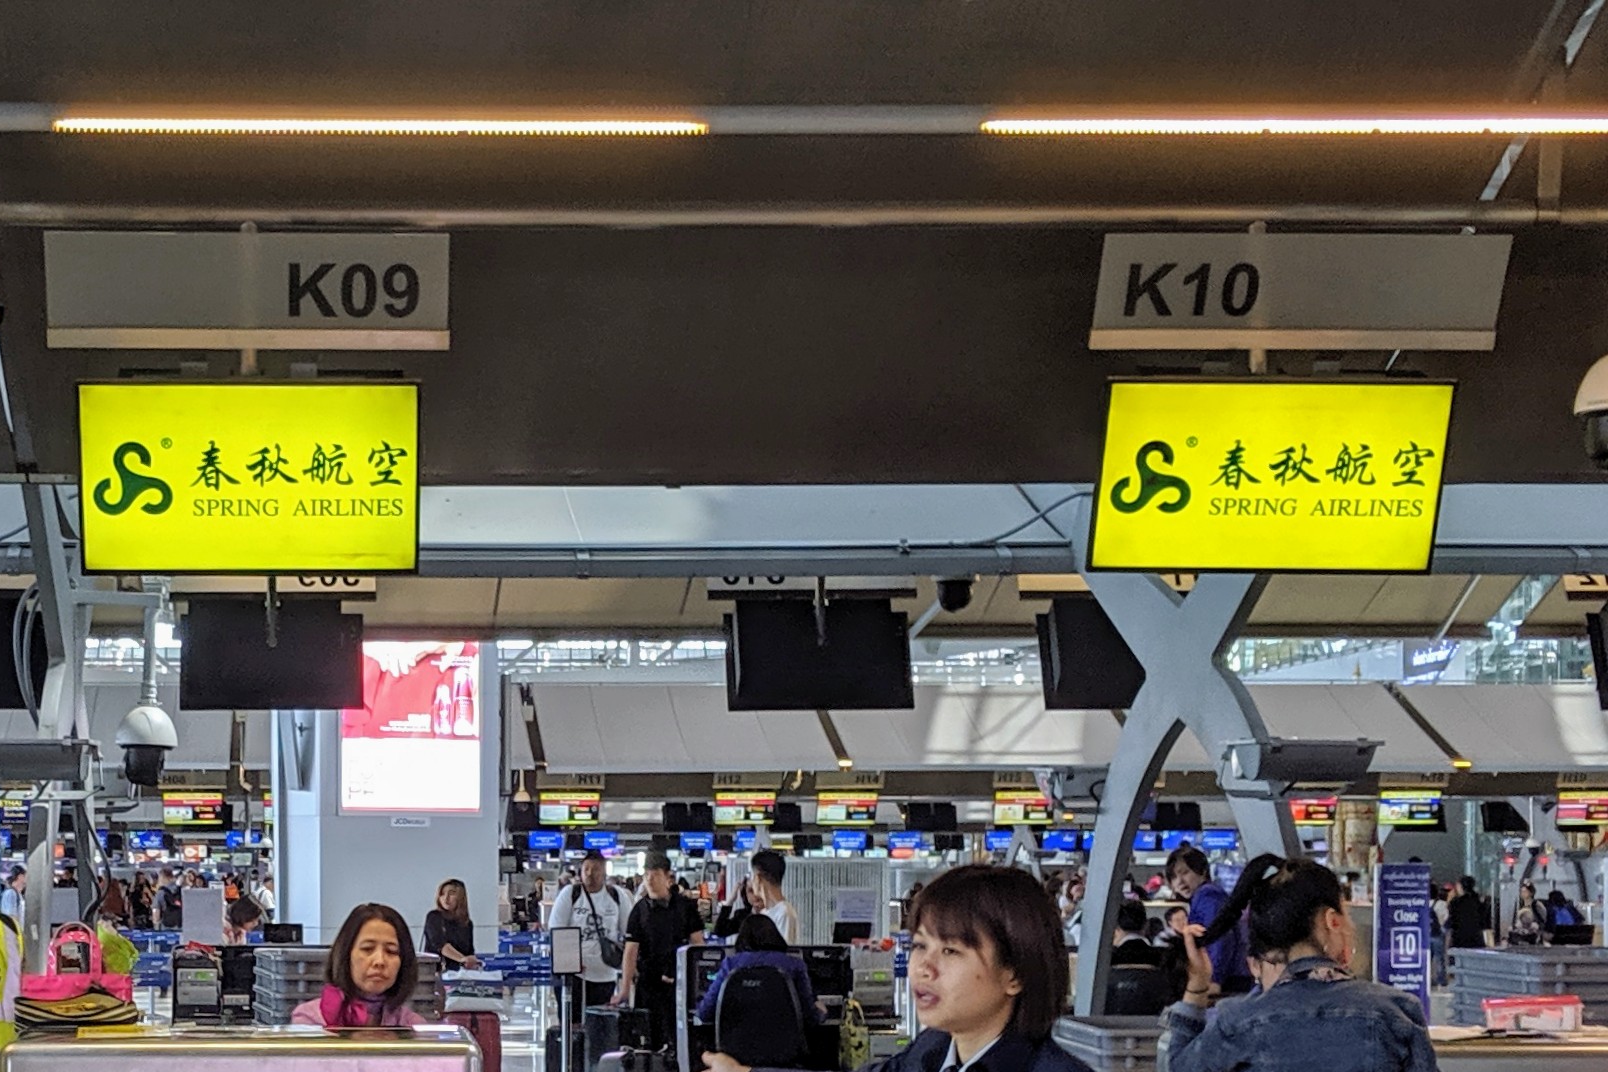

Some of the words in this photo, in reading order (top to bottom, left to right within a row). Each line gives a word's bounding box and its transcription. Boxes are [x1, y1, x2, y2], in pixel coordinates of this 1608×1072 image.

[288, 262, 421, 318] K09
[1122, 262, 1261, 317] K10
[190, 440, 409, 491] 春秋航空
[1208, 439, 1436, 491] 春秋航空
[192, 498, 279, 517] SPRING
[292, 498, 404, 517] AIRLINES
[1208, 497, 1298, 516] SPRING
[1309, 498, 1424, 518] AIRLINES
[717, 774, 742, 784] H12
[1393, 909, 1420, 923] Close
[1395, 932, 1416, 956] 10
